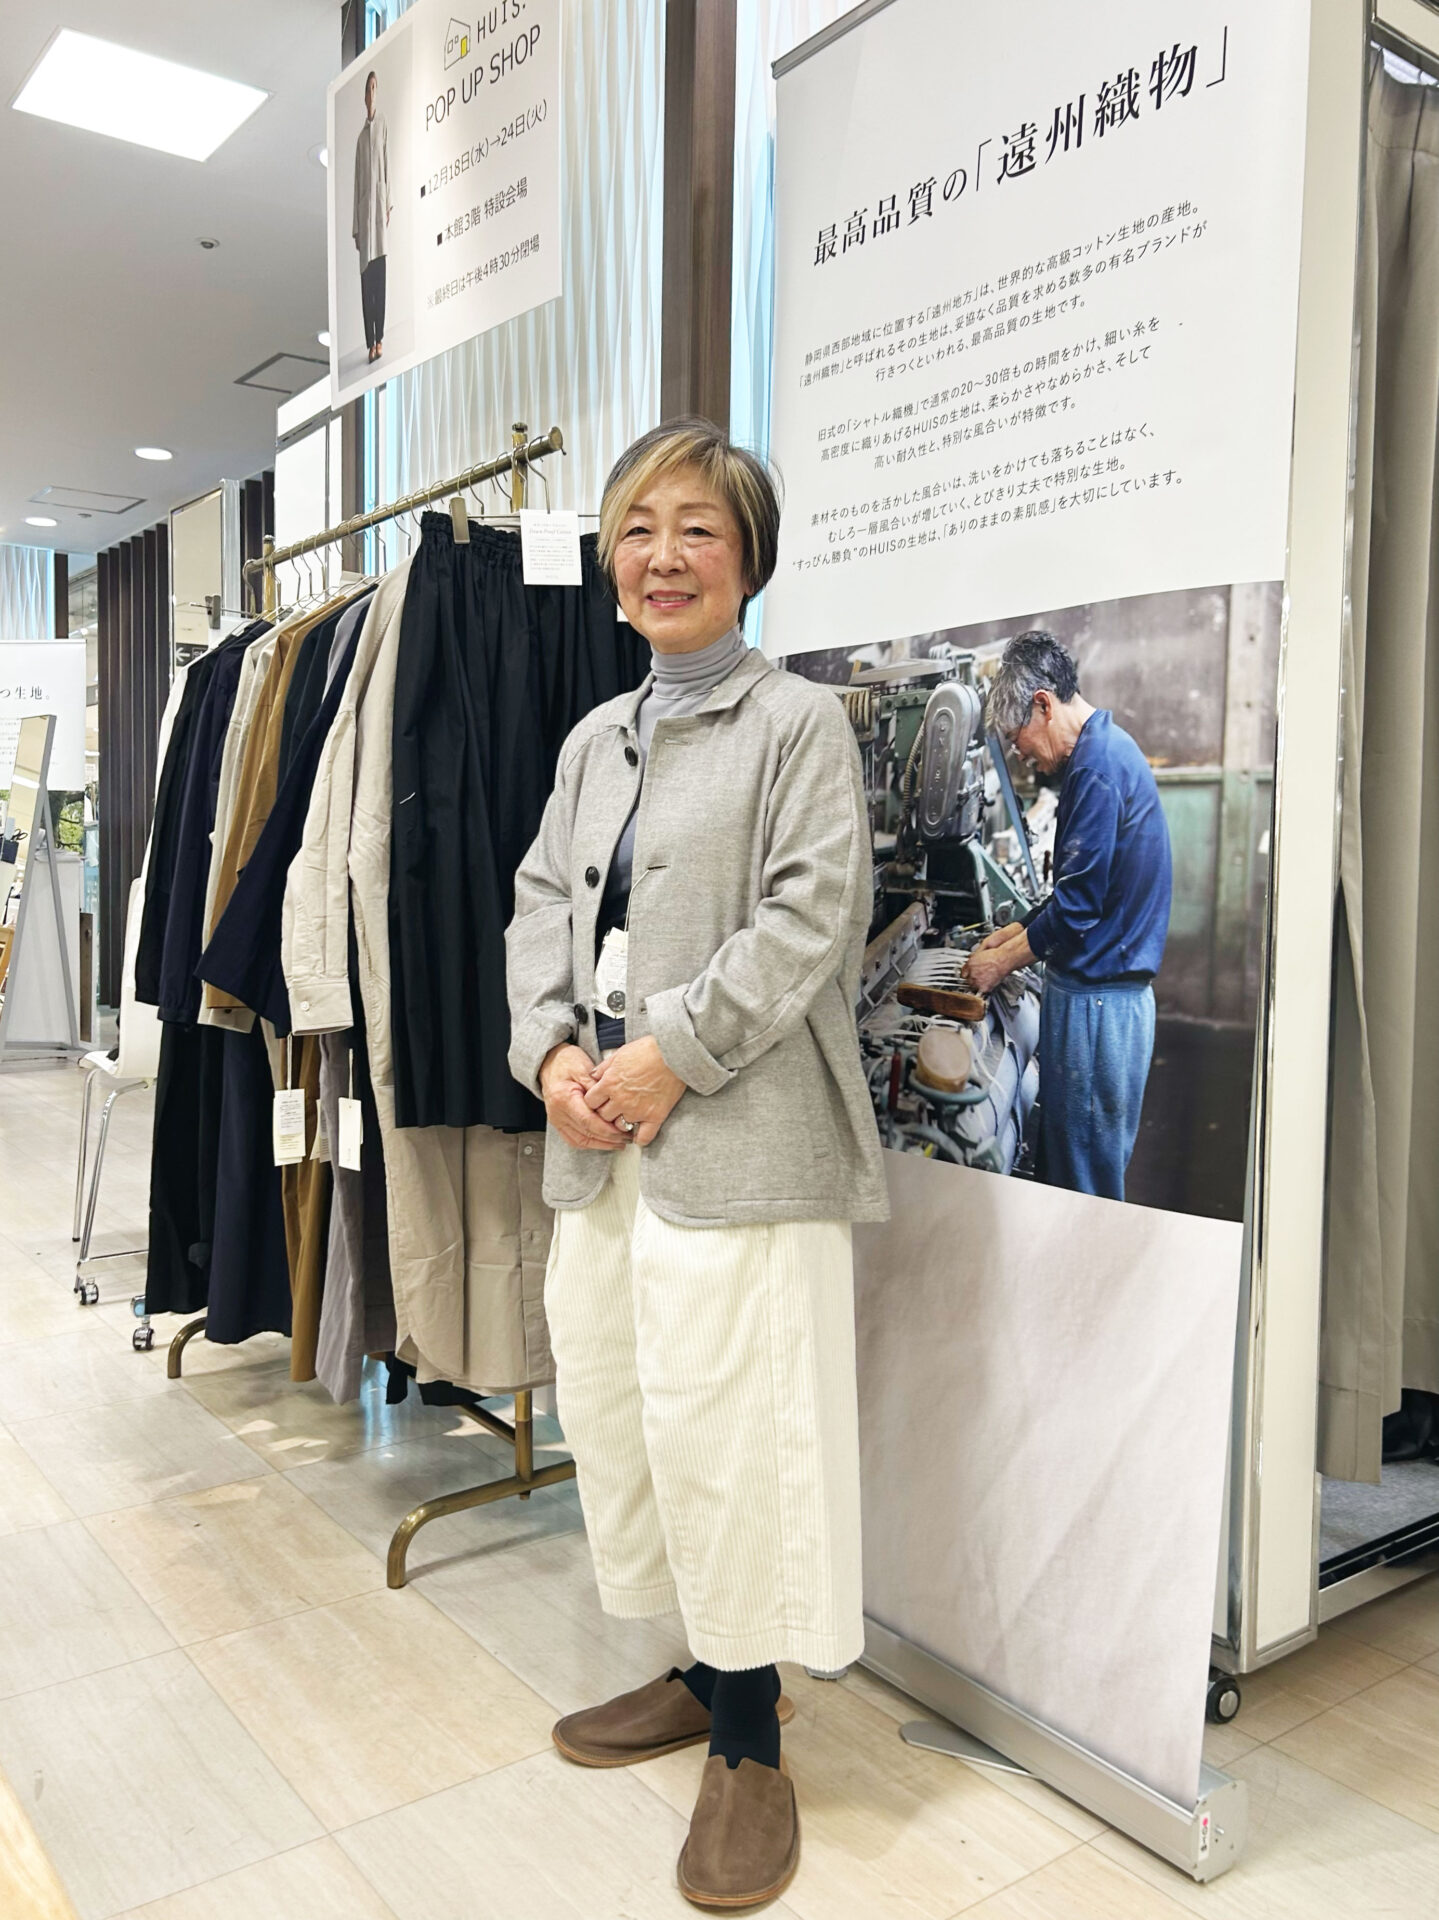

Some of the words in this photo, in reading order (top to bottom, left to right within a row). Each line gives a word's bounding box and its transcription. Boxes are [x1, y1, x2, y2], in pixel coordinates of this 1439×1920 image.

[425, 87, 456, 132] POP
[461, 65, 484, 104] UP
[489, 24, 541, 84] SHOP
[813, 25, 1228, 267] 最高品質の「遠州織物」
